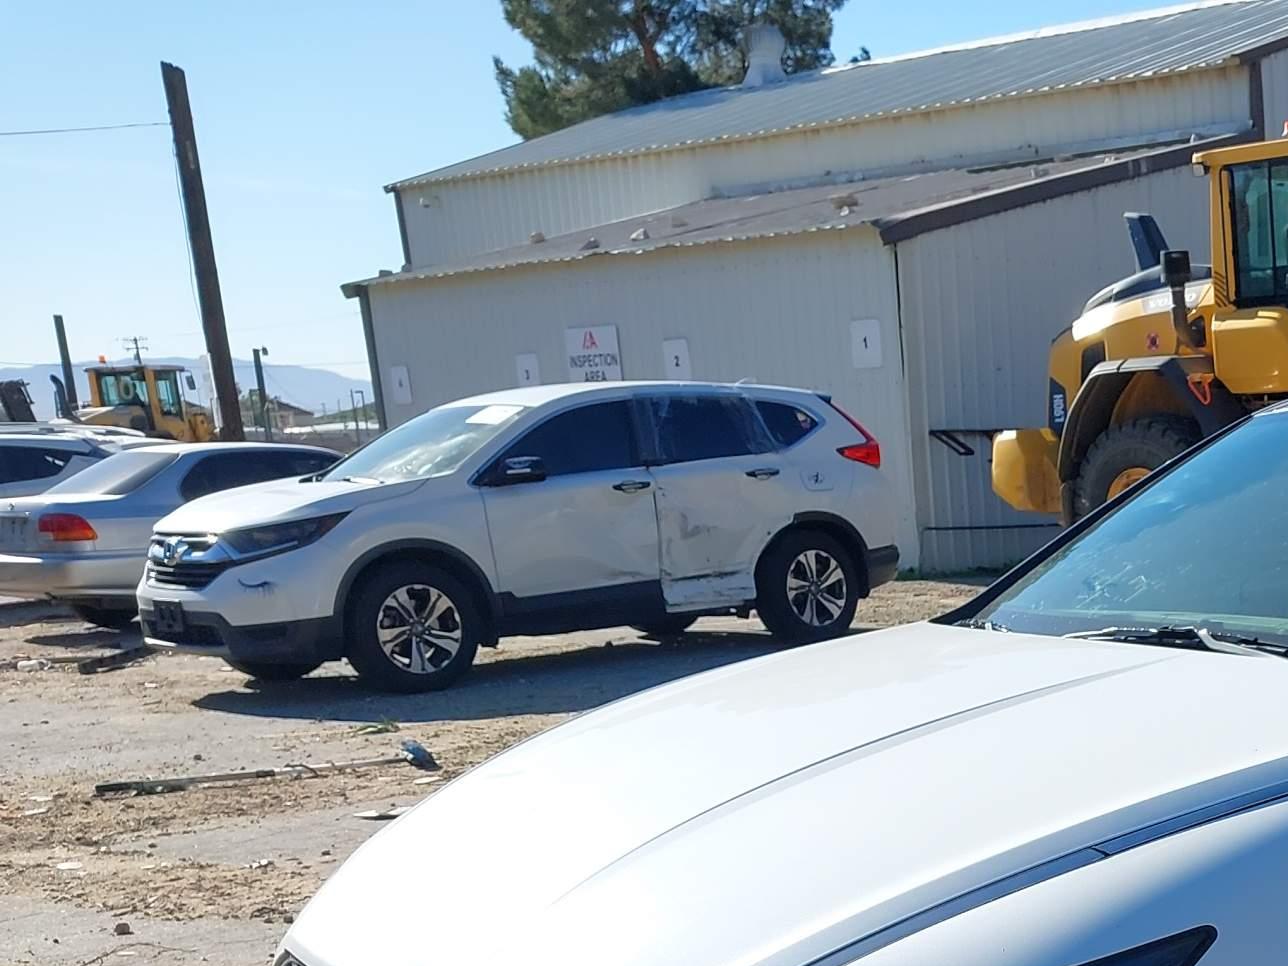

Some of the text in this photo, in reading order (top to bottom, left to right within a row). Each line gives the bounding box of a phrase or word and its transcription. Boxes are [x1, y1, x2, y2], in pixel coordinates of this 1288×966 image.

[863, 336, 869, 350] 1
[569, 353, 618, 369] INSPECTION
[673, 354, 681, 368] 2
[584, 370, 608, 382] AREA
